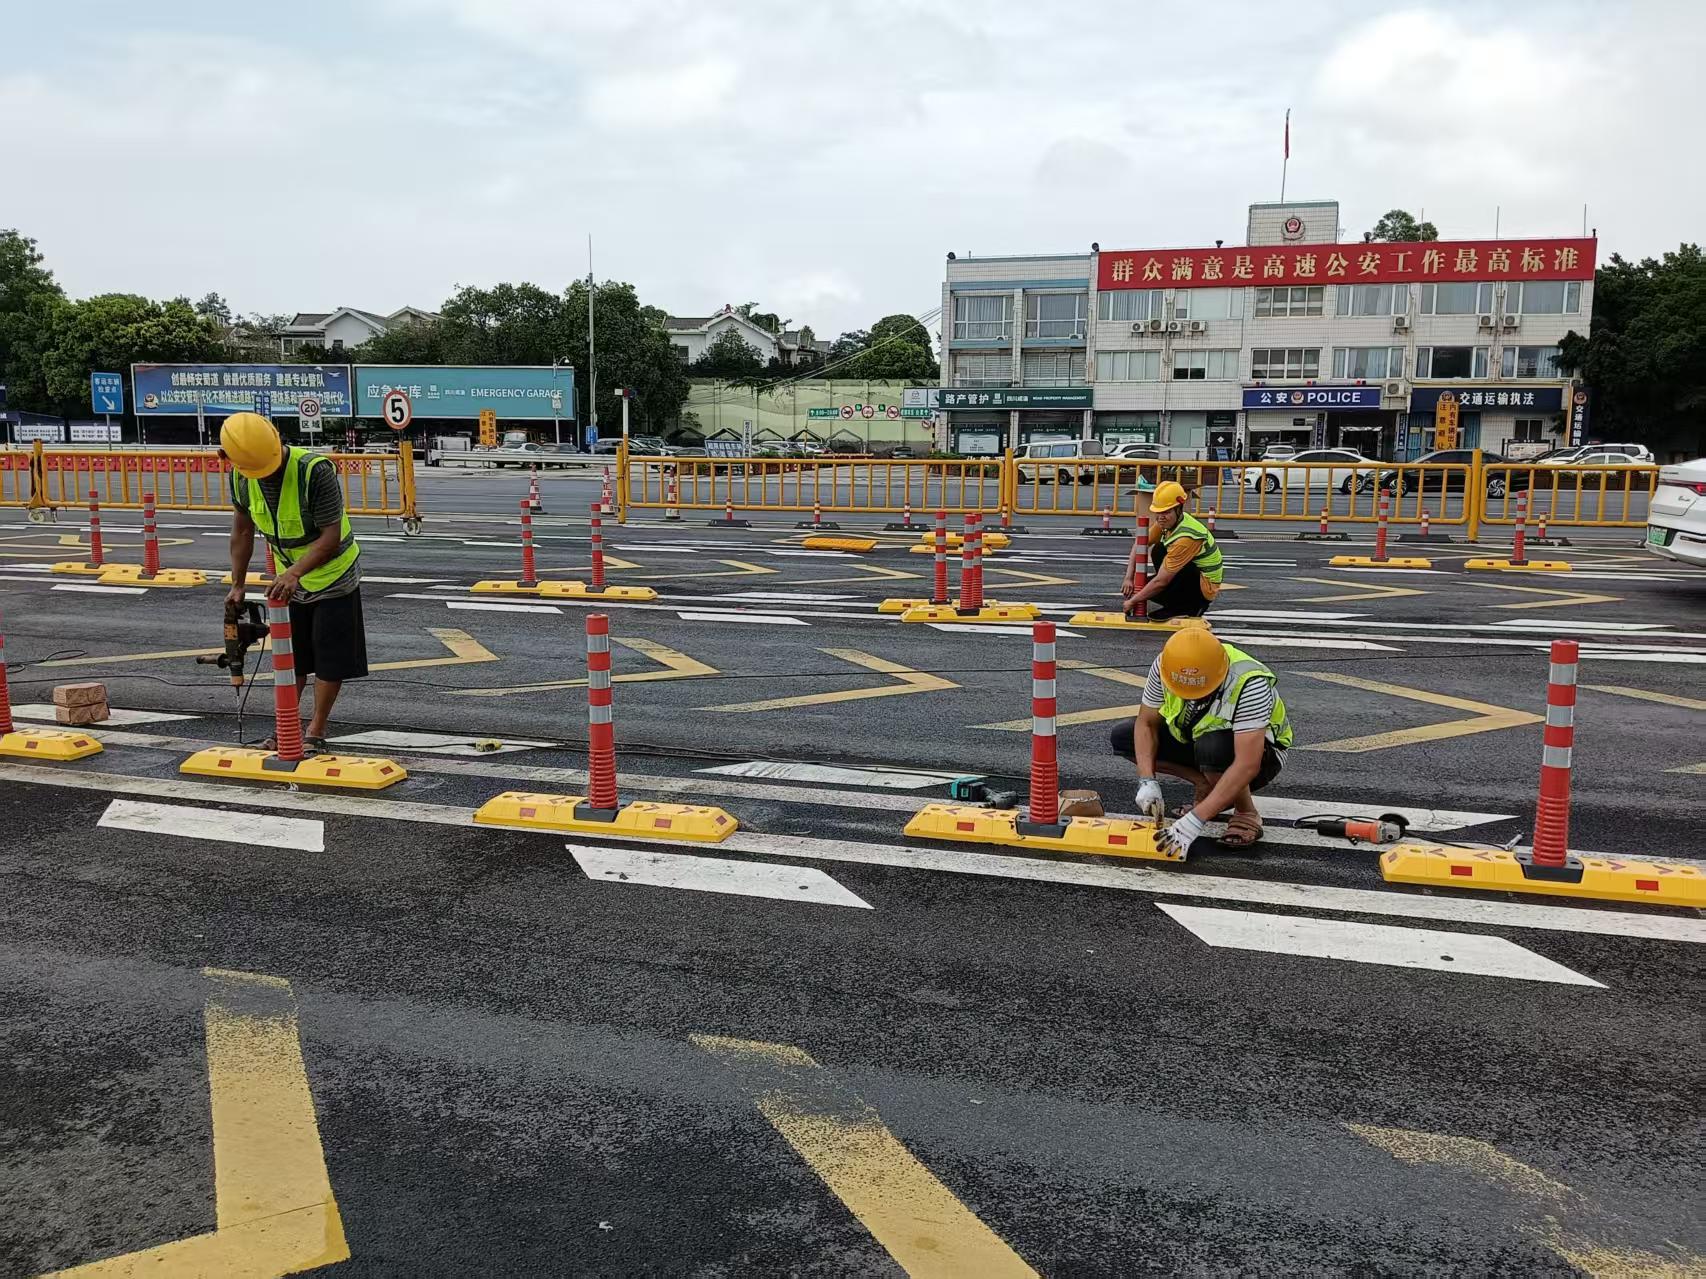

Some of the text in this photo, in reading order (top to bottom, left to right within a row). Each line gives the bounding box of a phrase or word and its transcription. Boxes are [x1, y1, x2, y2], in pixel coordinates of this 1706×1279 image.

[1111, 248, 1579, 282] 群众满意是高速公安工作最高标准
[223, 372, 272, 388] 做最优质服务
[275, 373, 325, 388] 建最专业警队
[471, 388, 563, 398] EMERGENCY GARAGE
[944, 393, 989, 405] 路产管护
[1260, 392, 1288, 404] 公安
[1307, 391, 1361, 403] POLICE
[1459, 392, 1535, 406] 交通运输执法
[304, 403, 316, 412] 20
[391, 398, 405, 423] 5
[301, 420, 320, 429] 区域
